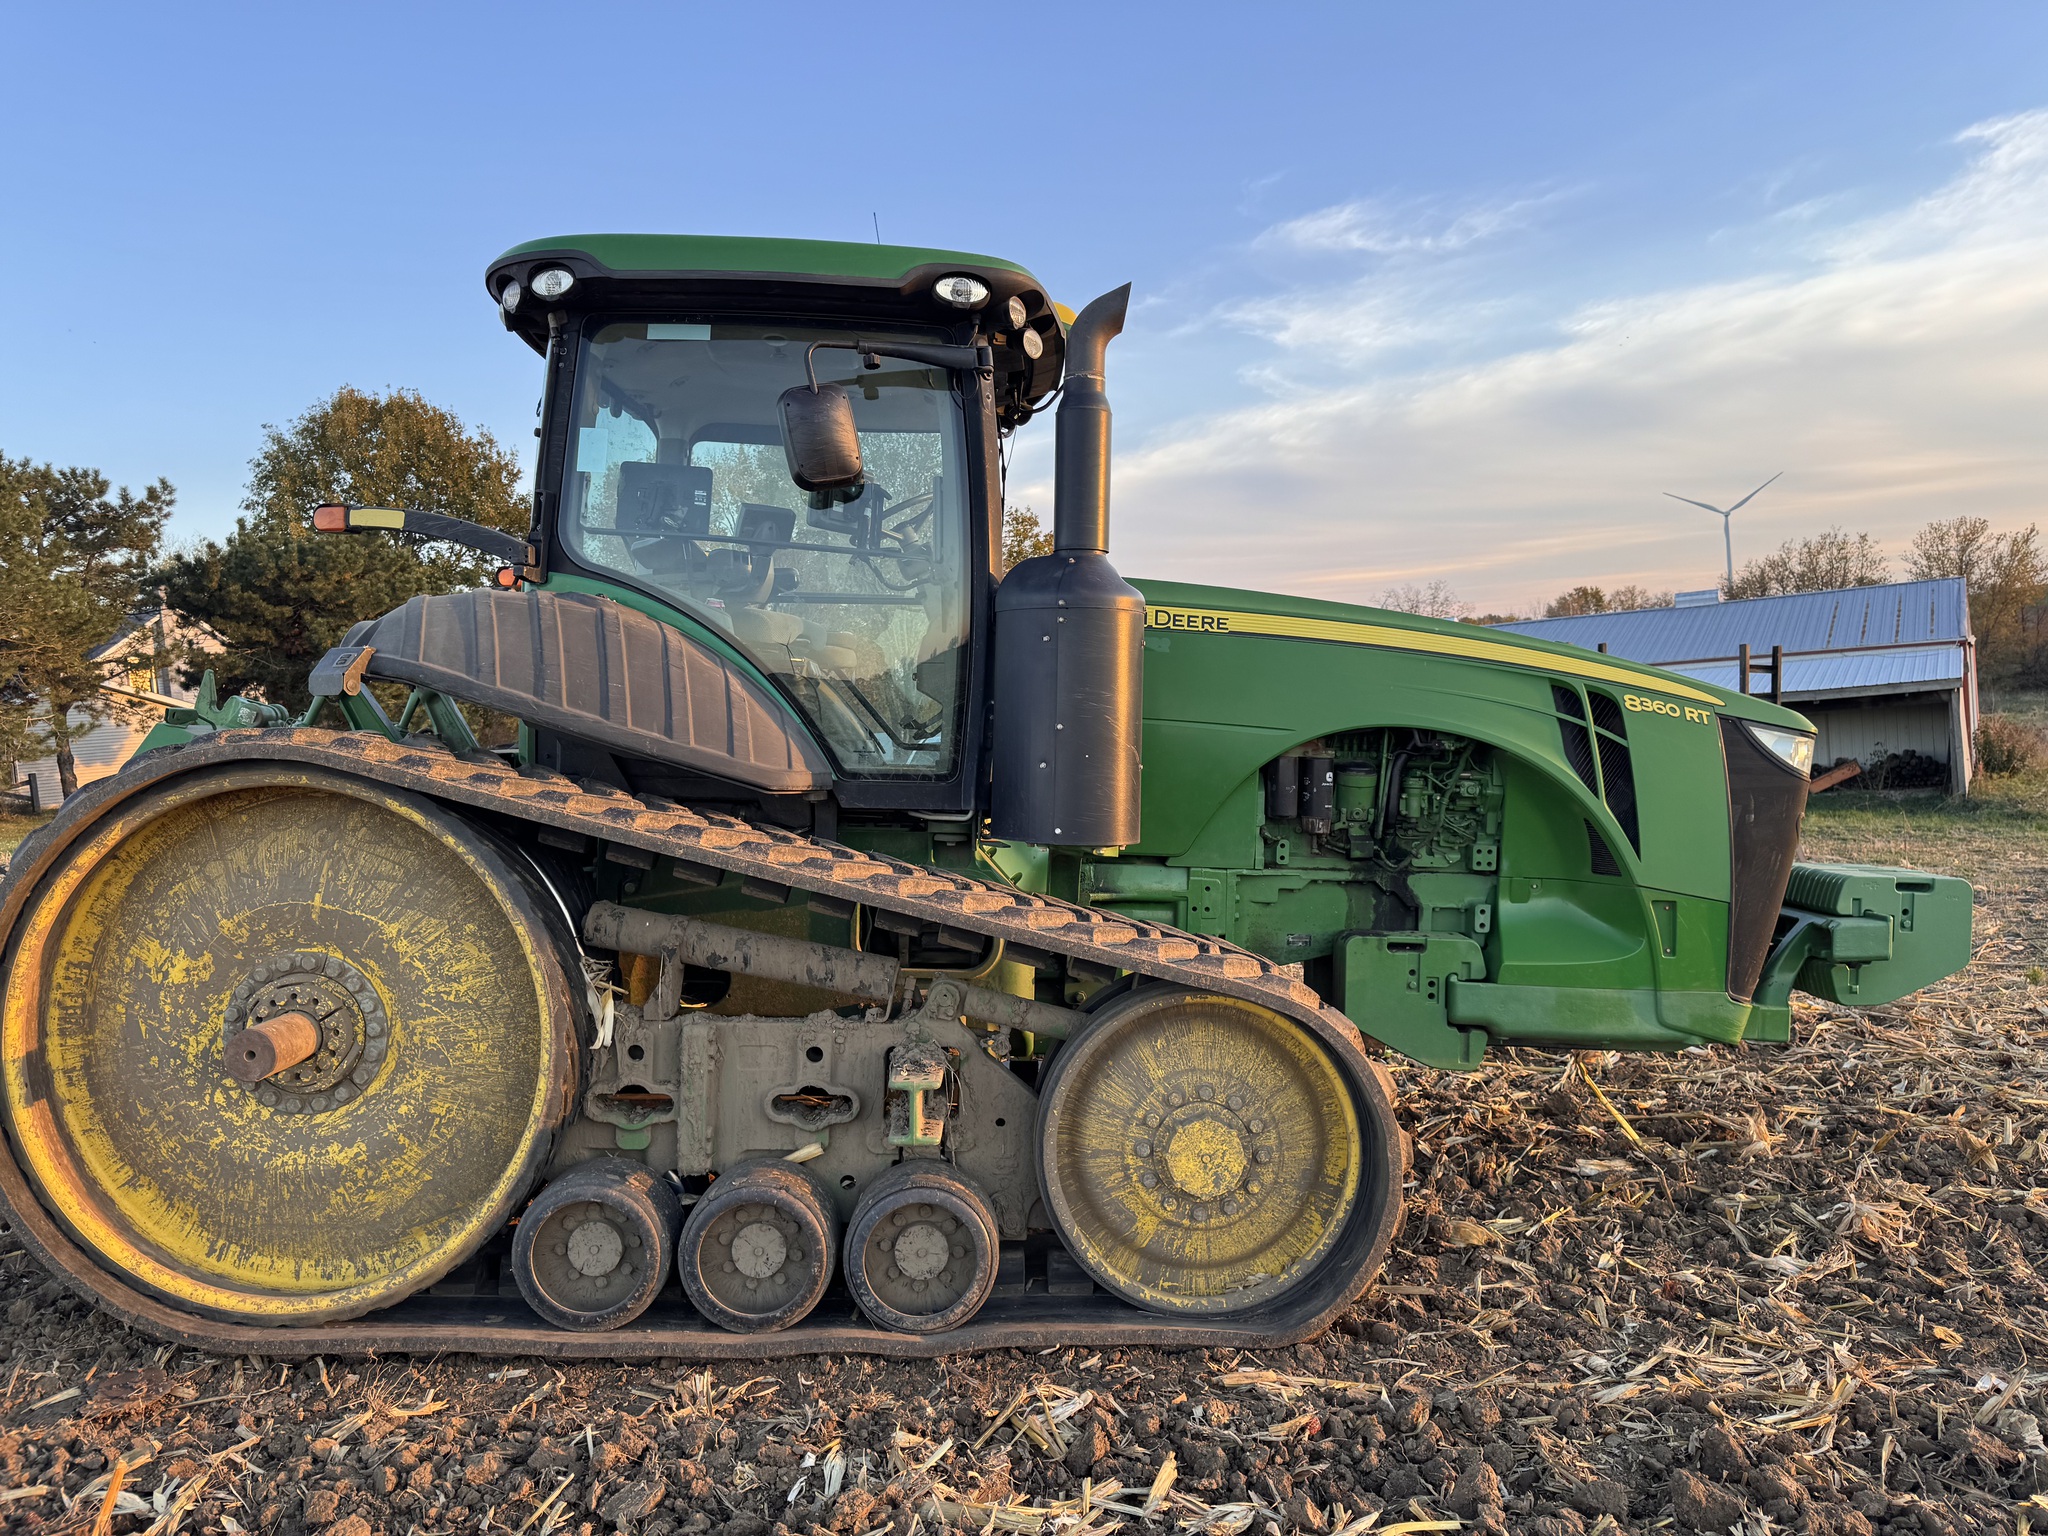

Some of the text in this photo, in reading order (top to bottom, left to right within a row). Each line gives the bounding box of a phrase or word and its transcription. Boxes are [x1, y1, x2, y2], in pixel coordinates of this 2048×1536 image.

[1154, 609, 1229, 631] DEERE
[1623, 694, 1711, 725] 8360 RT
